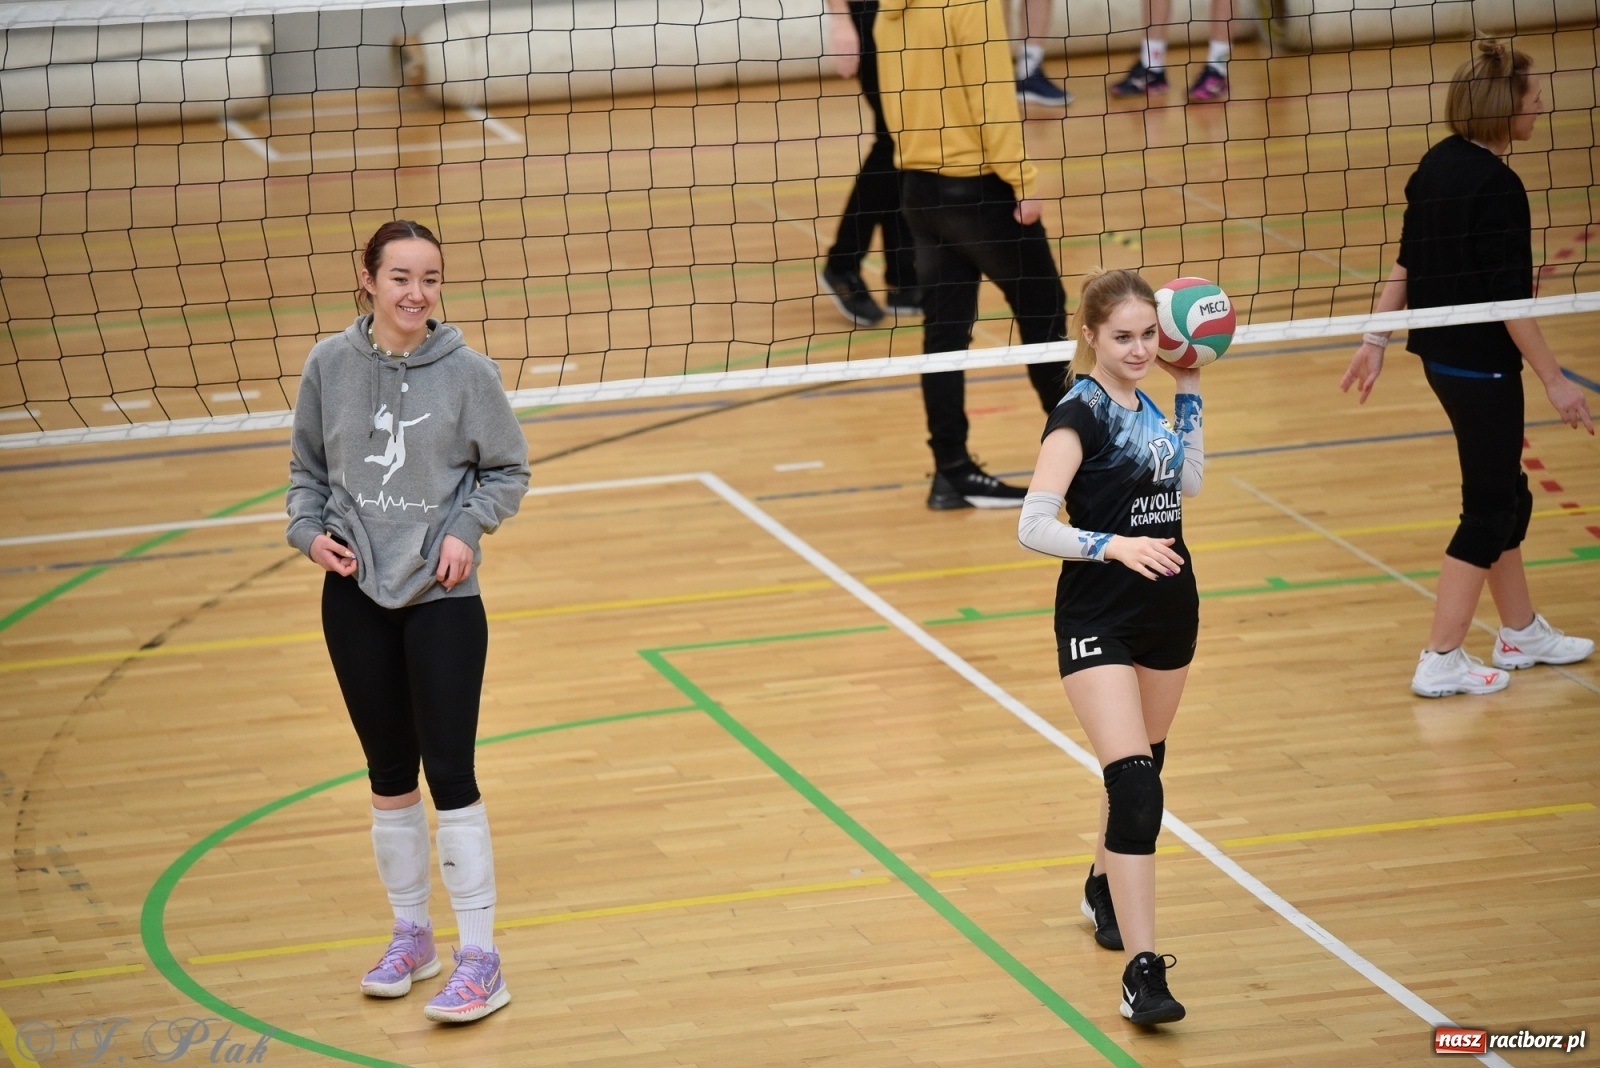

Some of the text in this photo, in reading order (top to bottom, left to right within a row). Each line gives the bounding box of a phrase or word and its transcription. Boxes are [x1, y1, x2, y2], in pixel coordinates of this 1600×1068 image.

[1199, 300, 1228, 316] MECZ
[1147, 436, 1175, 483] 12
[1130, 496, 1149, 513] PV
